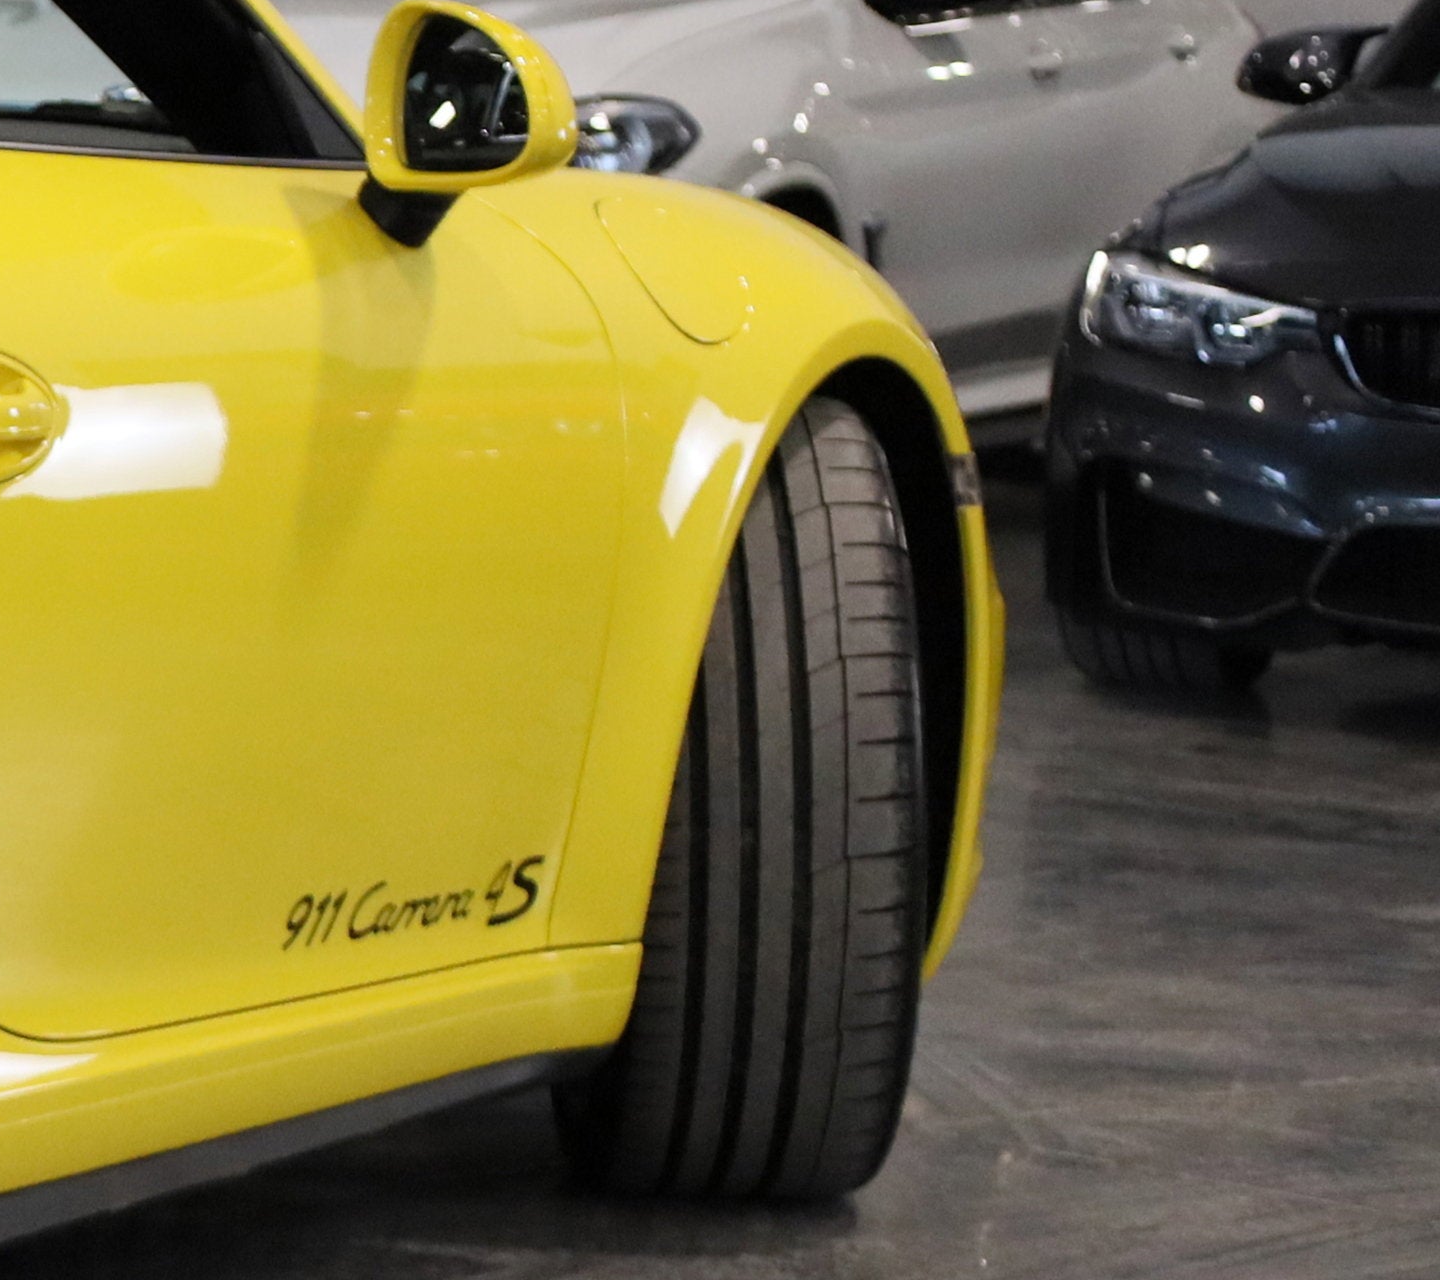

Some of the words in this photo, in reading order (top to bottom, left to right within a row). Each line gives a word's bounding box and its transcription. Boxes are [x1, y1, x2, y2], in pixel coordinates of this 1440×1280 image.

[281, 888, 348, 951] 911
[348, 880, 475, 940] Carrera
[484, 854, 546, 926] 4S
